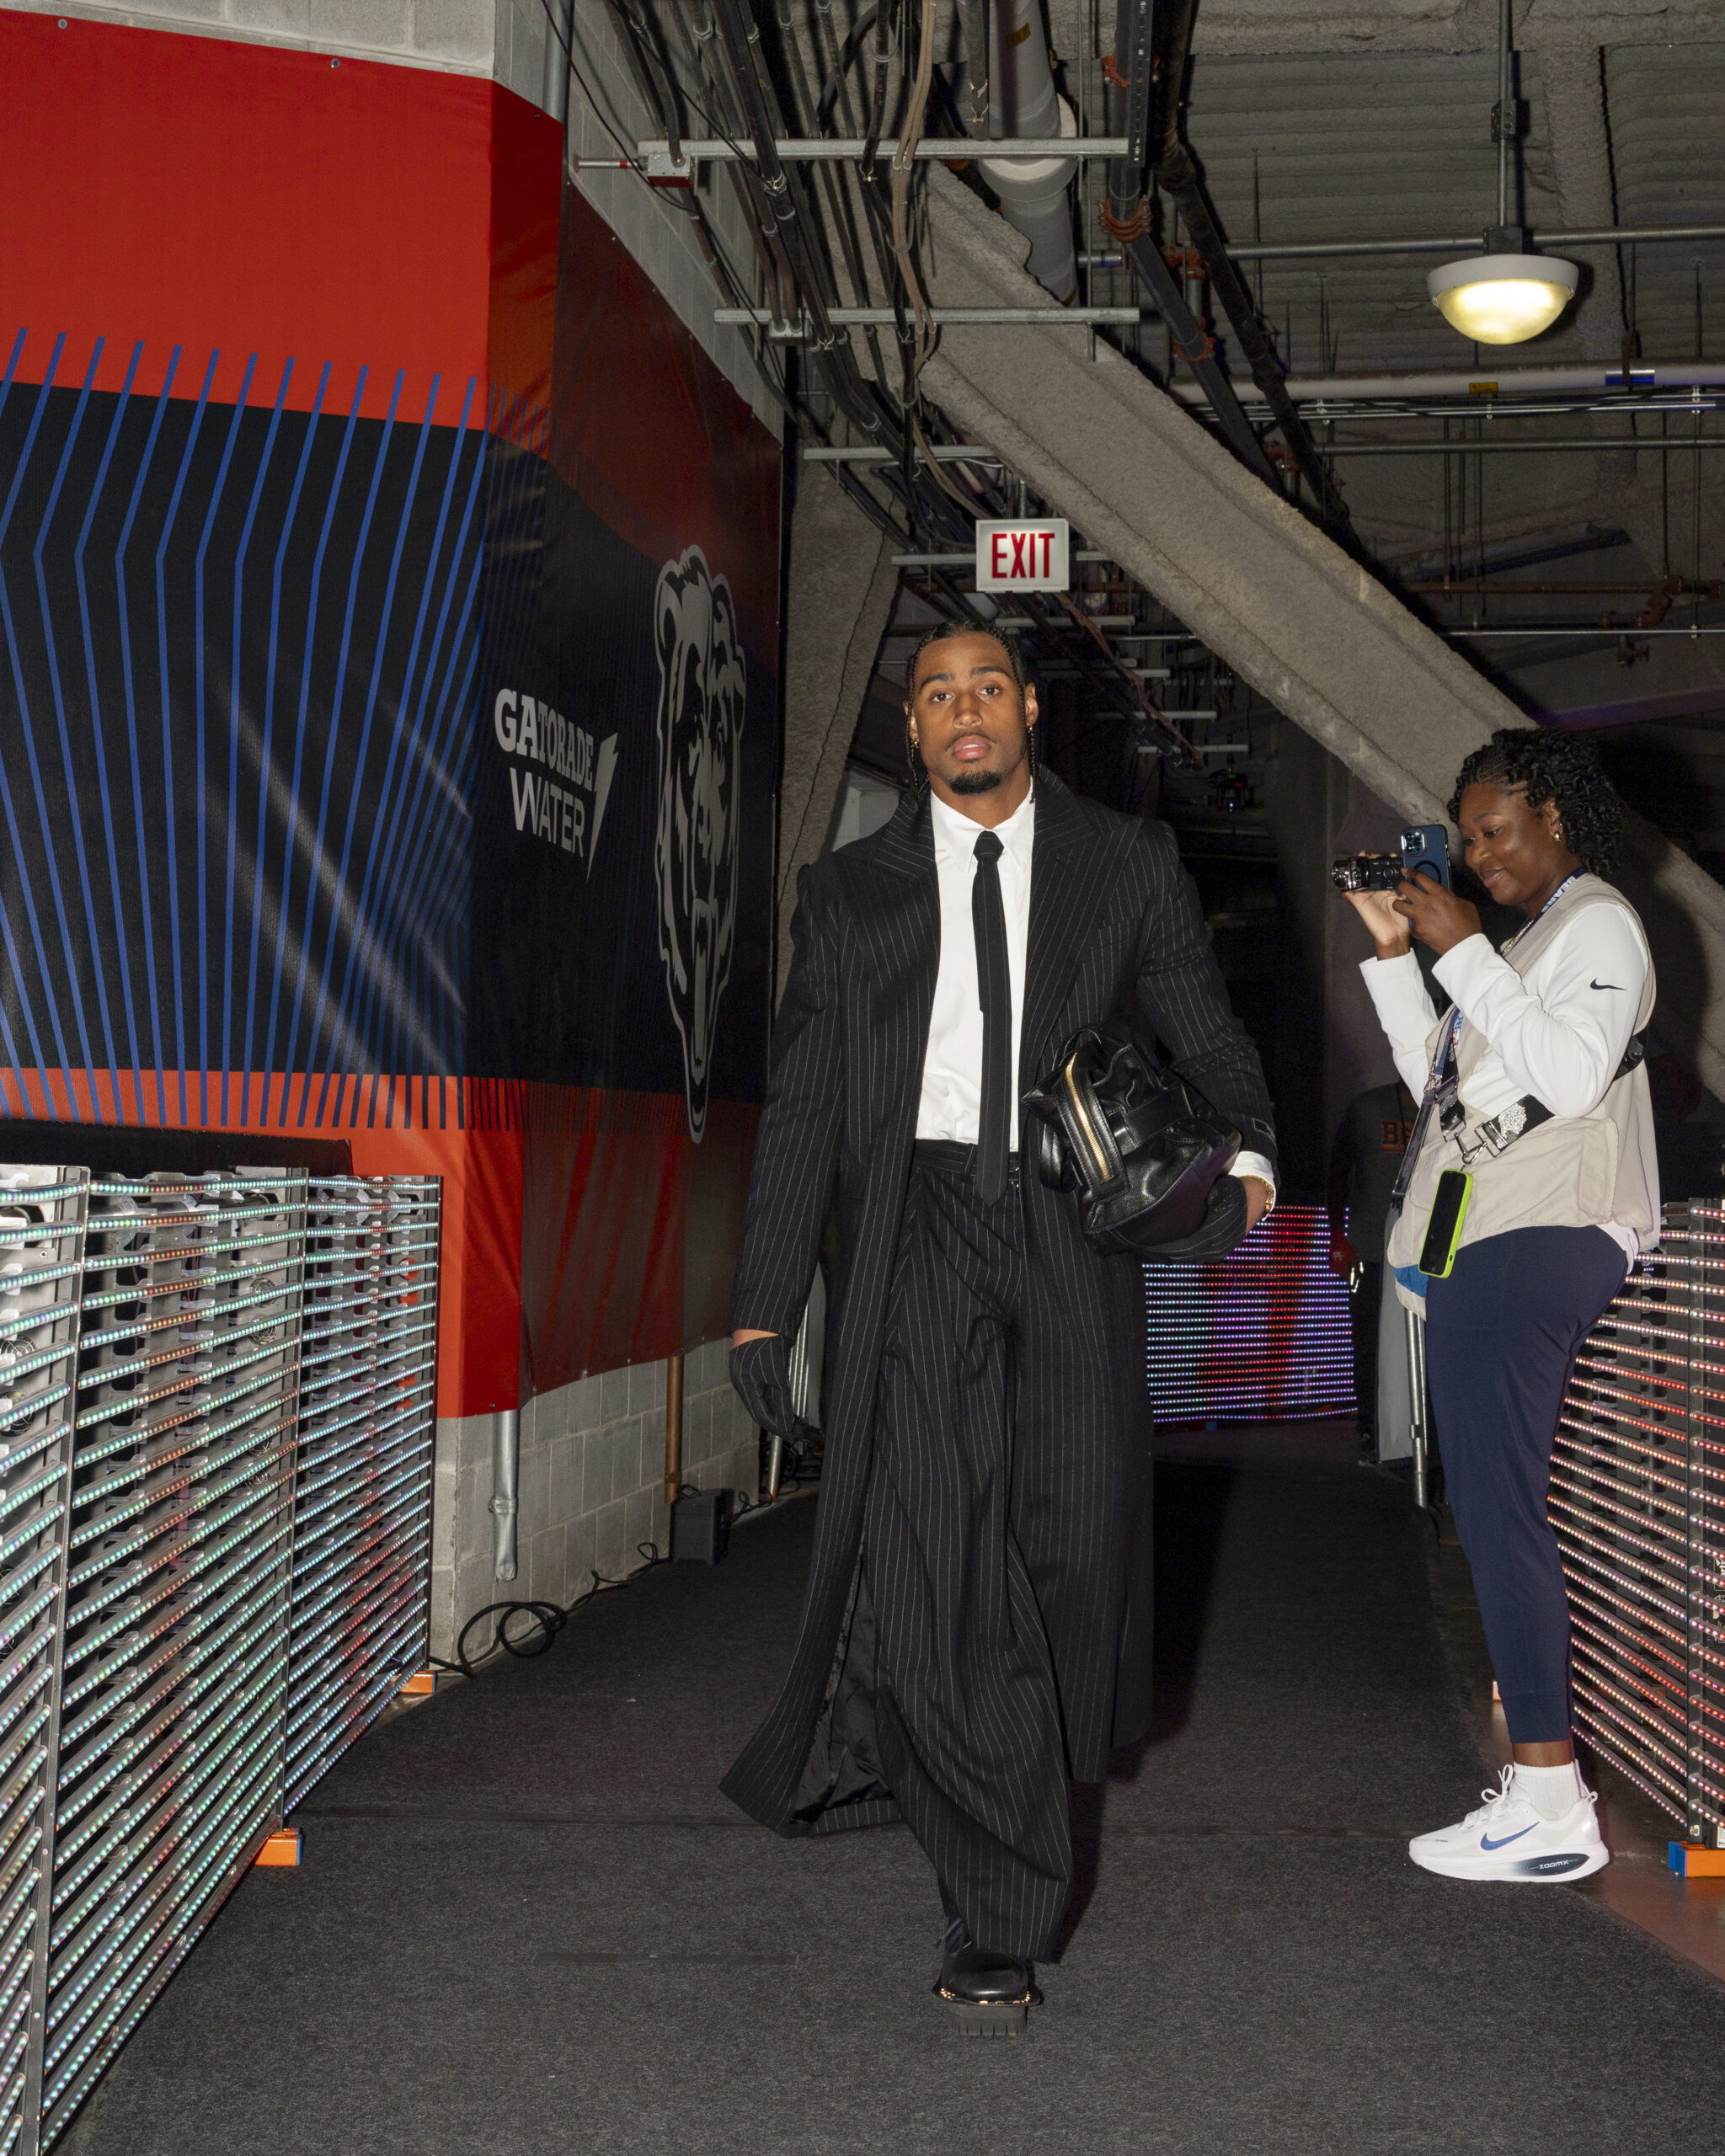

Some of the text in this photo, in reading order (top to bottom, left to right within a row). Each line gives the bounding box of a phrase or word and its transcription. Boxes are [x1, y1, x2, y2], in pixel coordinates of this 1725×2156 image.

[991, 532, 1055, 579] EXIT
[494, 687, 594, 791] GATORADE
[509, 766, 585, 857] WATER
